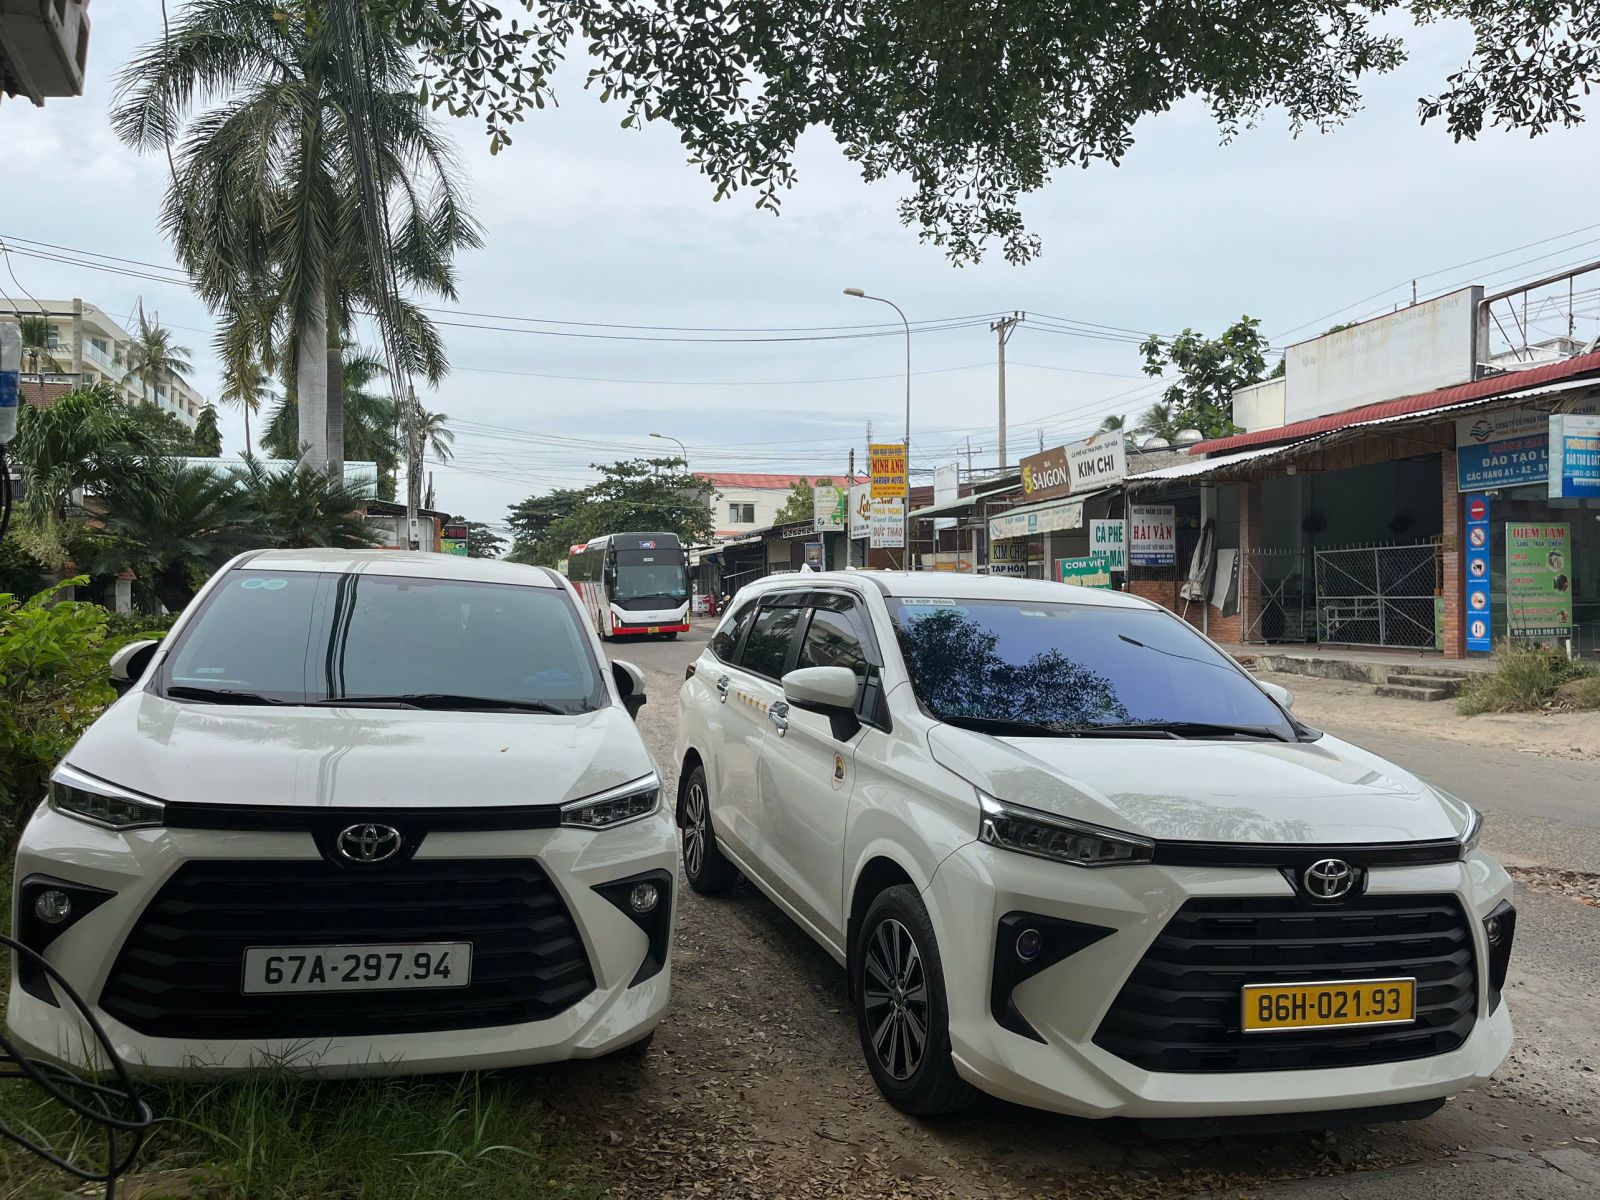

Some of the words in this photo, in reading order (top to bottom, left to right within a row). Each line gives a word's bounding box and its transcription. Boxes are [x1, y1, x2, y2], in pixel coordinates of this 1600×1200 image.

[1512, 450, 1537, 464] TẠO
[872, 459, 889, 473] MINH
[890, 459, 905, 473] ANH
[1077, 459, 1096, 478] KIM
[1096, 454, 1115, 474] CHI
[1504, 466, 1513, 476] A1
[1521, 465, 1531, 474] A2
[1096, 522, 1106, 543] CÀ
[1108, 522, 1123, 543] PHÊ
[993, 544, 1008, 560] KIM
[991, 565, 1006, 575] TẠP
[1007, 564, 1025, 573] HÓA
[1065, 560, 1087, 570] CƠM
[1089, 558, 1106, 570] VIỆT
[264, 951, 451, 985] 67A-297.94
[1258, 988, 1401, 1022] 86H-021.93
